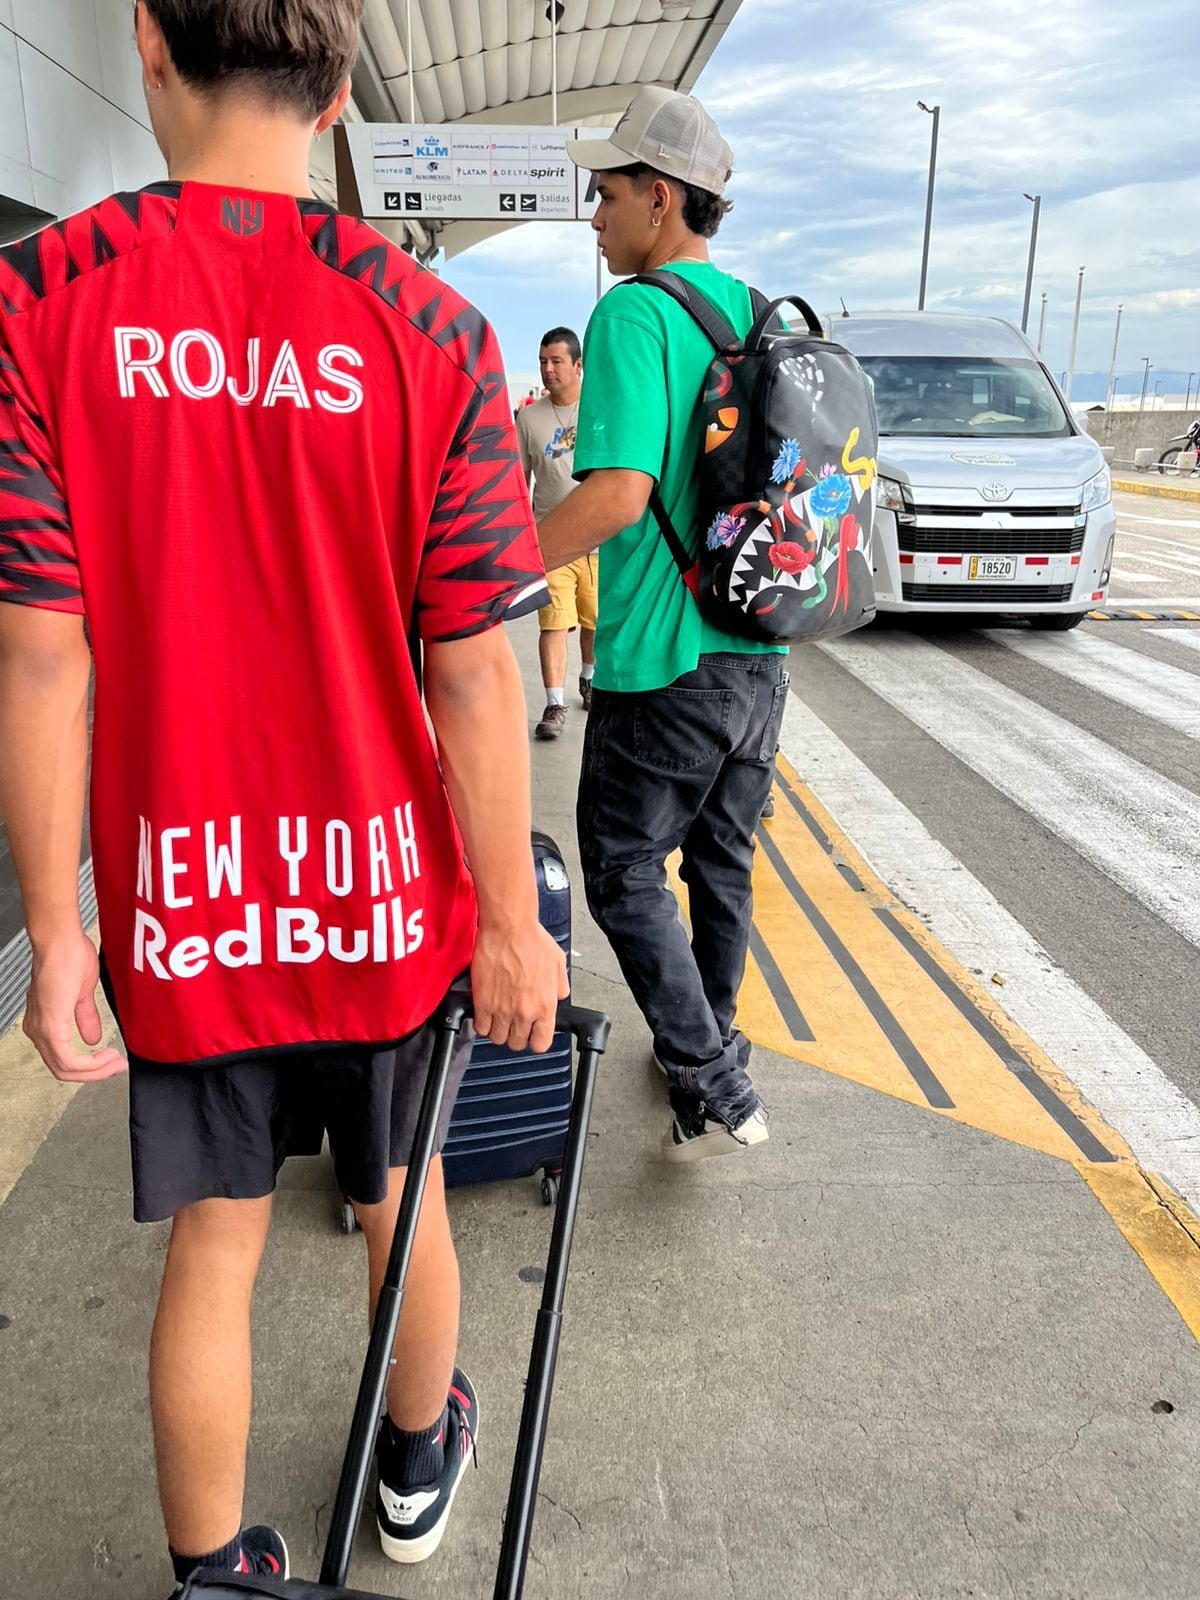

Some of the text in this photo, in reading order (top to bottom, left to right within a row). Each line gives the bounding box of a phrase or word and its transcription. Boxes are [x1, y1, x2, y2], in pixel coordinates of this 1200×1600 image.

[416, 147, 448, 156] KLM
[530, 167, 565, 179] spirit
[424, 193, 462, 203] Llegadas
[540, 194, 570, 203] Salidas
[222, 196, 264, 235] NY
[114, 327, 364, 413] ROJAS
[982, 562, 1011, 574] 18520
[136, 800, 421, 909] NEW YORK
[133, 896, 424, 981] Red Bulls
